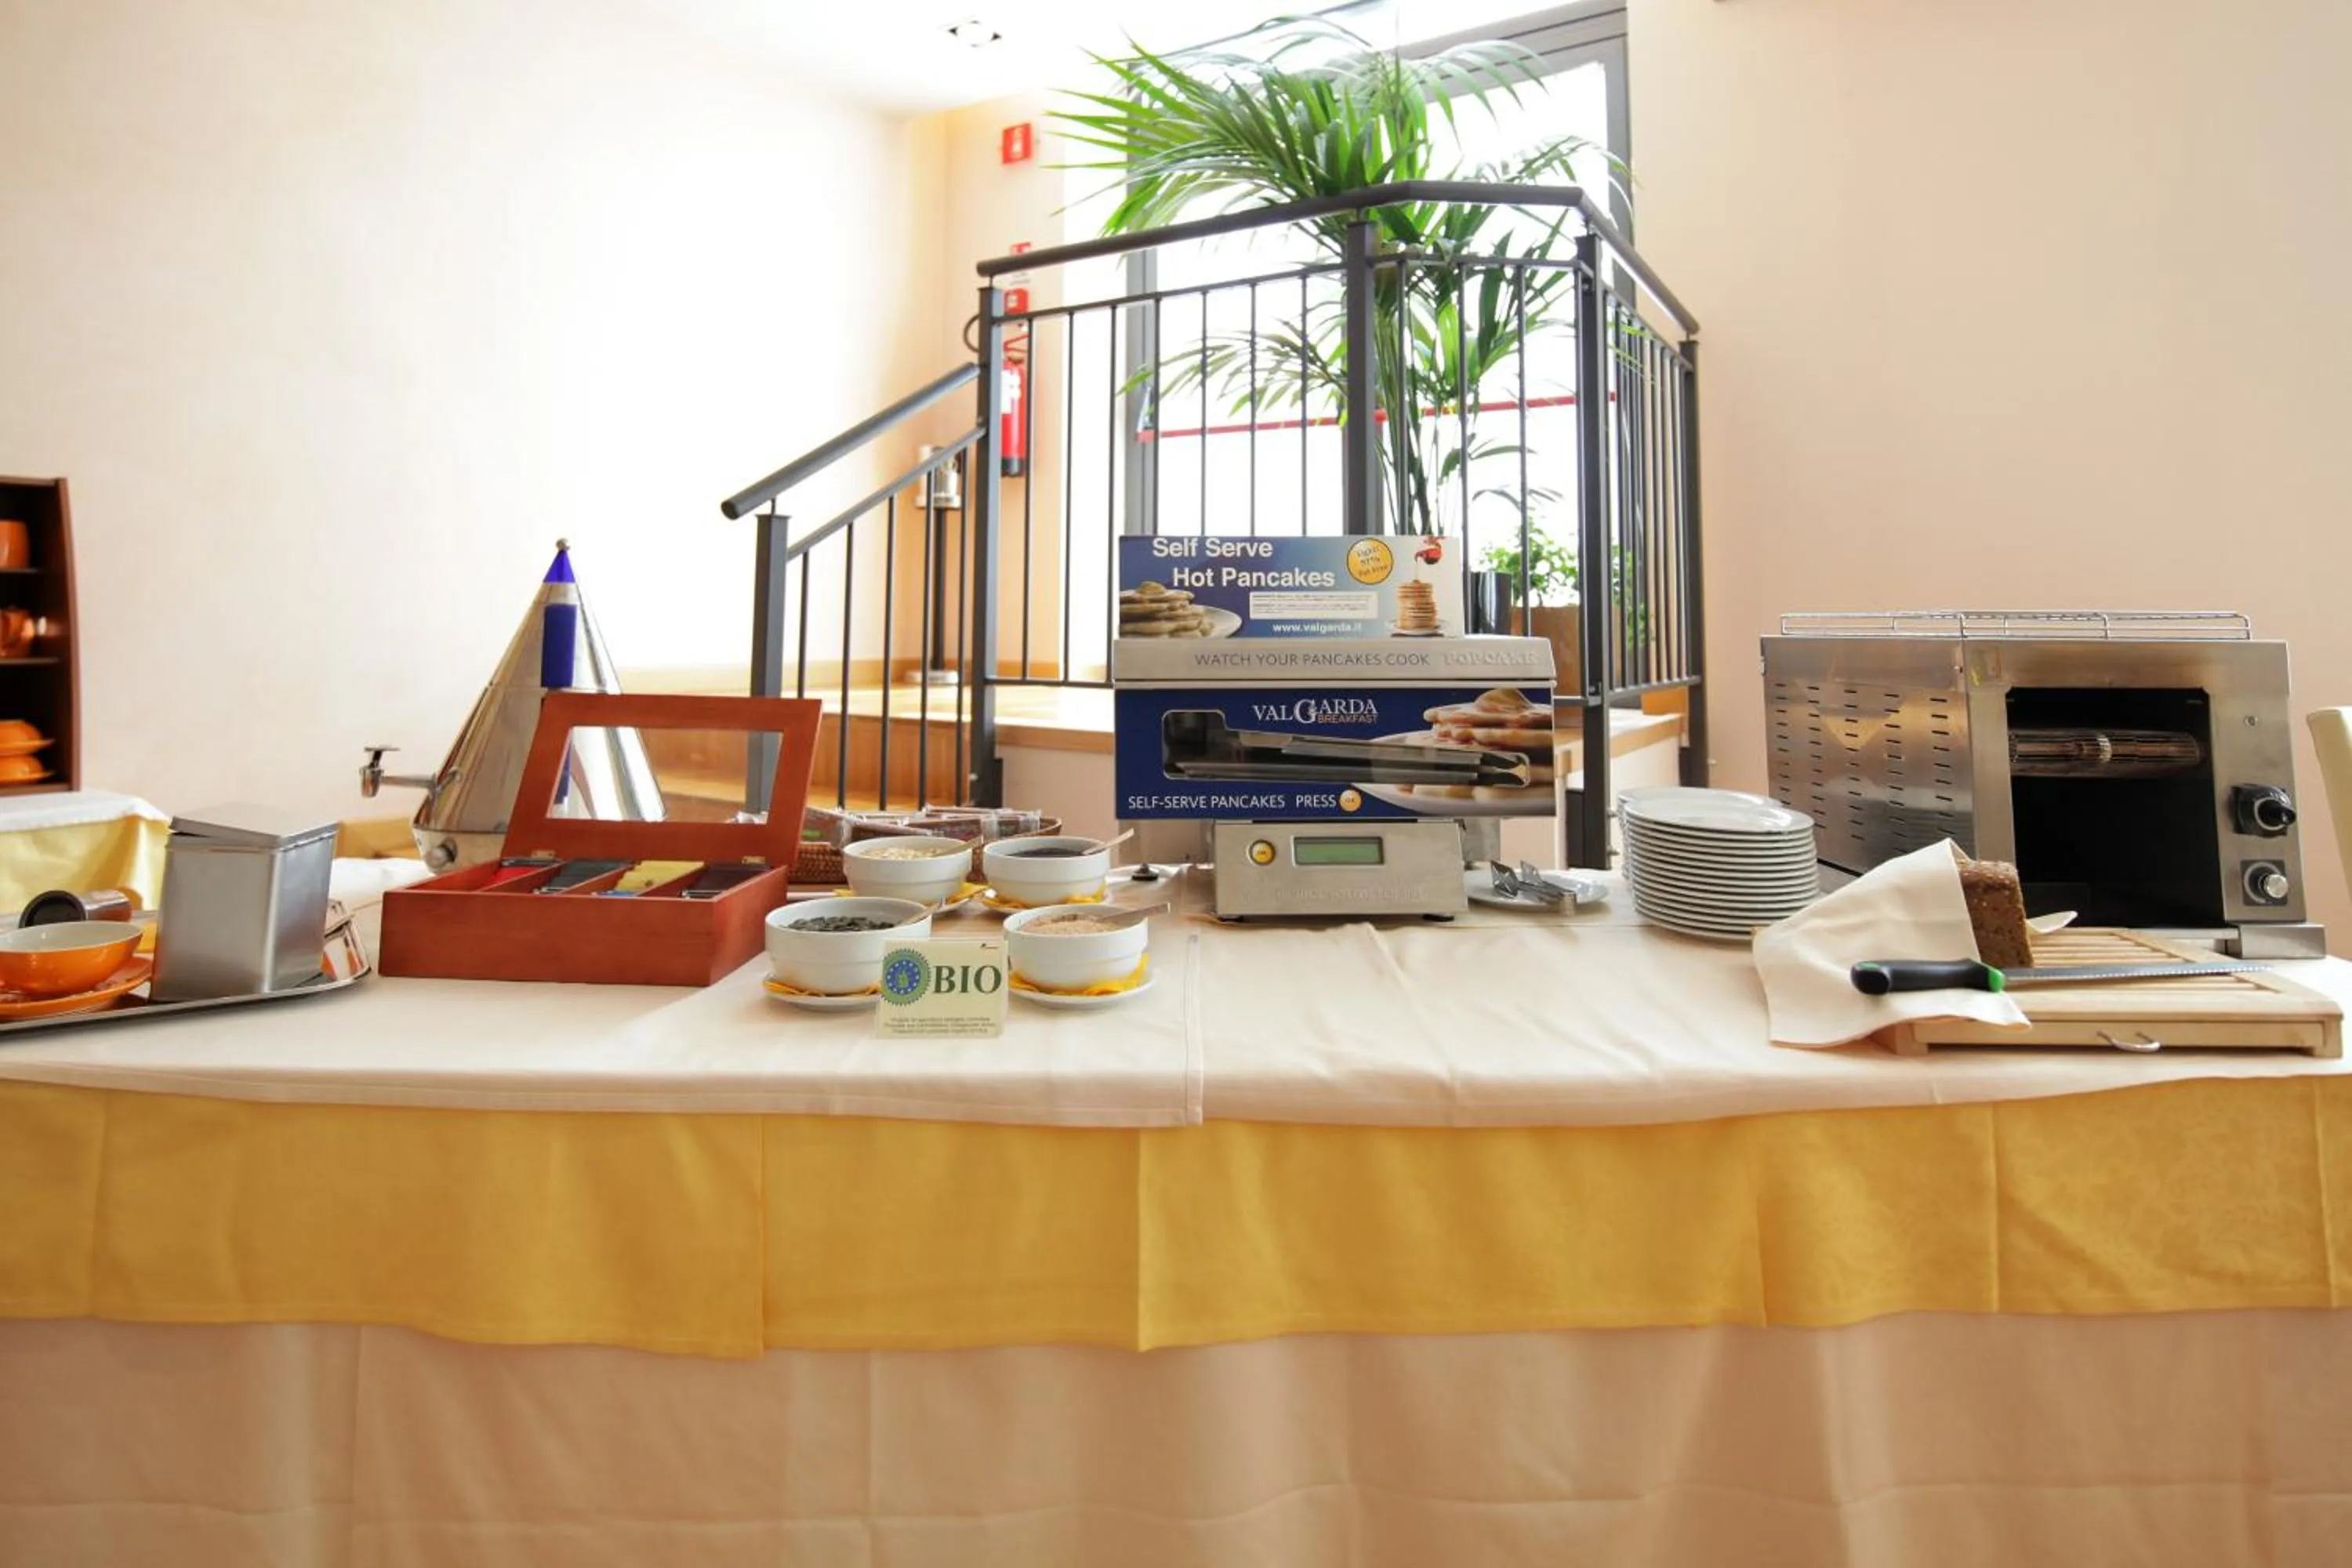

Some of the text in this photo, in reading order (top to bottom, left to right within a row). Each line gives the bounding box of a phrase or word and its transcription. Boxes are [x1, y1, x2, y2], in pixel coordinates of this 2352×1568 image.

[1152, 537, 1273, 557] Self Serve
[1173, 567, 1335, 586] Hot Pancakes
[1272, 622, 1363, 634] www.valgarda.it
[1195, 653, 1430, 666] WATCH YOUR PANCAKES COOK
[1317, 713, 1378, 724] BREAKFAST
[1128, 794, 1337, 809] SELF-SERVE PANCAKES PRESS
[932, 965, 1003, 994] BIO
